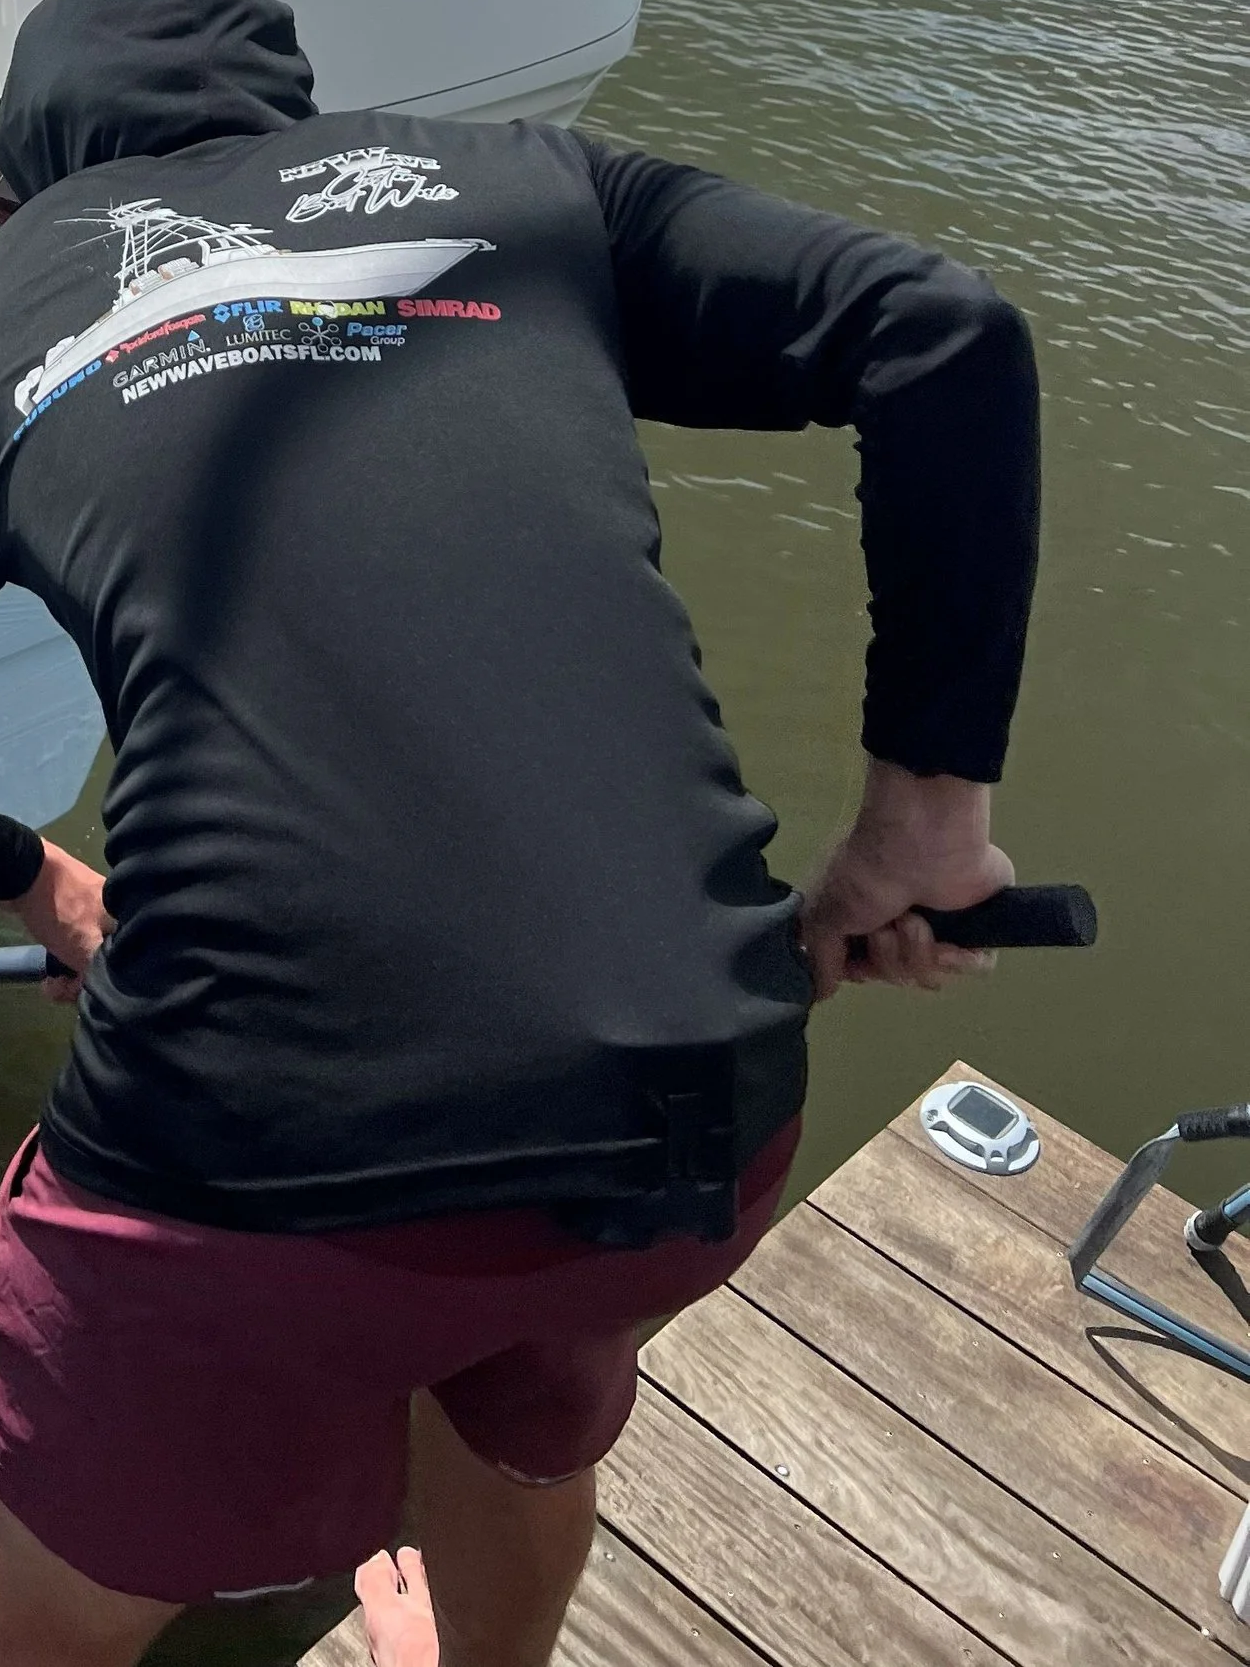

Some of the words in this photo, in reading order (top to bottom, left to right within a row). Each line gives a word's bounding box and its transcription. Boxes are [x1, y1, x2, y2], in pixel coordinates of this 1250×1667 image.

[230, 299, 284, 318] FLIR
[396, 298, 502, 321] SIMRAD
[225, 328, 293, 347] LUMITEC
[346, 321, 408, 336] Pacer
[370, 335, 406, 346] Group
[121, 344, 382, 404] NEWWAVEBOATSFL.COM
